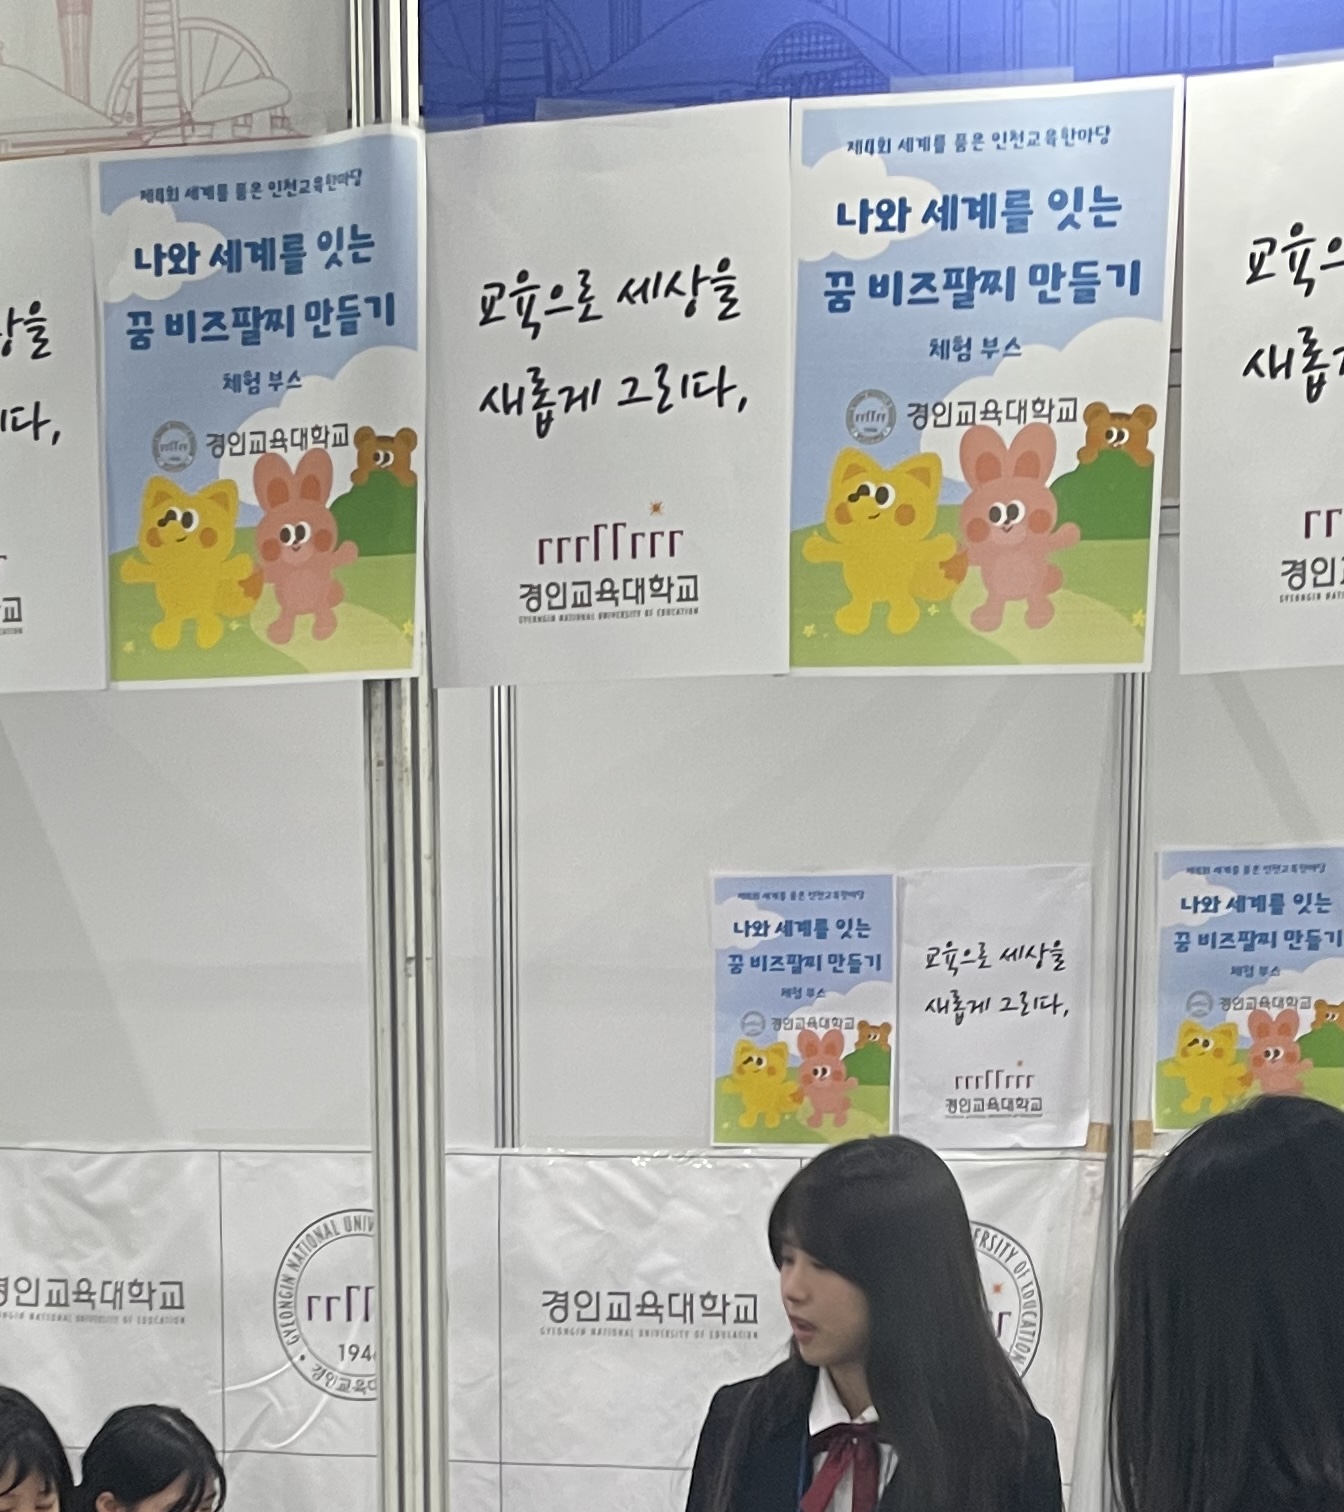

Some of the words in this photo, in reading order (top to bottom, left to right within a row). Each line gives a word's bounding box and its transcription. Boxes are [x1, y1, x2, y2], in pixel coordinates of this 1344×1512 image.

[837, 197, 912, 234] 나와
[921, 190, 1033, 234] 세계를
[1048, 185, 1122, 231] 잇는
[135, 241, 201, 277] 나와
[208, 233, 307, 275] 세계를
[317, 224, 375, 270] 잇는
[479, 269, 603, 340] 교육으로
[617, 257, 740, 321] 세상을
[824, 271, 855, 313] 꿈
[869, 266, 1016, 309] 비즈팔찌
[1029, 259, 1141, 304] 만들기
[126, 311, 154, 350] 꿈
[165, 304, 294, 346] 비즈팔찌
[305, 292, 395, 338] 만들기
[929, 335, 972, 362] 체험
[981, 337, 1022, 359] 부스
[223, 370, 261, 395] 체험
[268, 370, 302, 392] 부스
[479, 367, 601, 439] 새롭게
[618, 363, 747, 414] 그리다,
[908, 397, 1077, 430] 경인교육대학교
[207, 423, 349, 458] 경인교육대학교
[520, 574, 698, 614] 경인교육대학교
[1181, 896, 1221, 914] 나와
[1225, 892, 1284, 916] 세계를
[1294, 892, 1332, 915] 잇는
[733, 920, 770, 938] 나와
[774, 919, 827, 940] 세계를
[837, 918, 871, 939] 잇는
[1174, 931, 1191, 953] 꿈
[1198, 930, 1277, 952] 비즈팔찌
[1284, 929, 1342, 951] 만들기
[728, 954, 744, 974] 꿈
[750, 954, 822, 974] 비즈팔찌
[828, 953, 881, 974] 만들기
[926, 941, 991, 976] 교육으로
[1000, 940, 1065, 971] 세상을
[925, 989, 991, 1026] 새롭게
[999, 991, 1069, 1017] 그리다,
[946, 1097, 1042, 1114] 경인교육대학교
[286, 1219, 340, 1273] NATIONAL
[1014, 1261, 1031, 1280] OF
[542, 1290, 758, 1325] 경인교육대학교
[339, 1344, 376, 1362] 194
